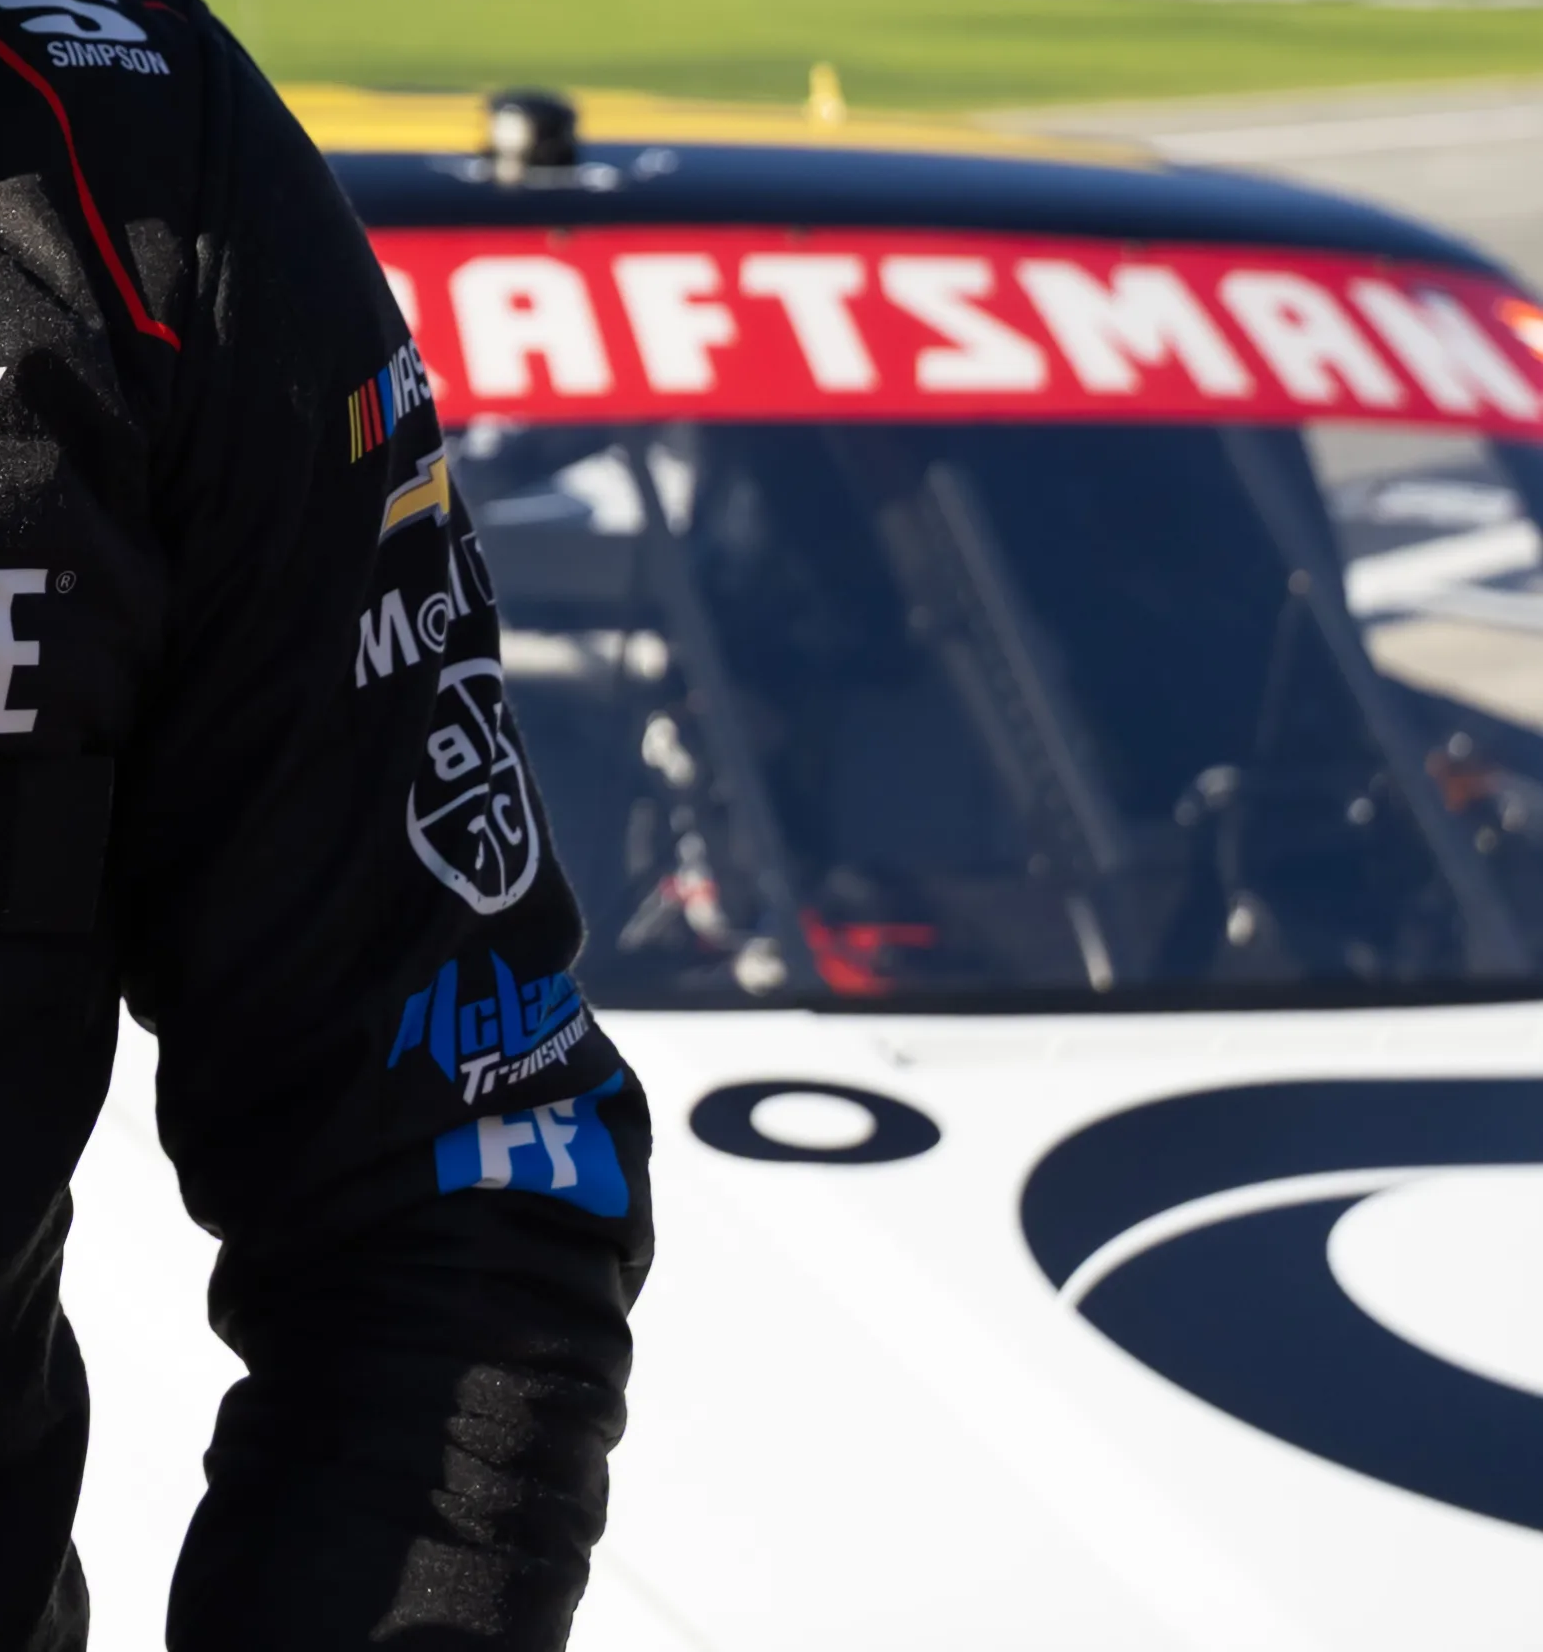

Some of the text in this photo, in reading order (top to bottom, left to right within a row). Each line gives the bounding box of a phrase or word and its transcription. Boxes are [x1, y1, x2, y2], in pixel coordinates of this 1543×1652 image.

[46, 40, 171, 76] SIMPSON
[381, 252, 1541, 423] AFTSMAN
[388, 337, 432, 427] NAS
